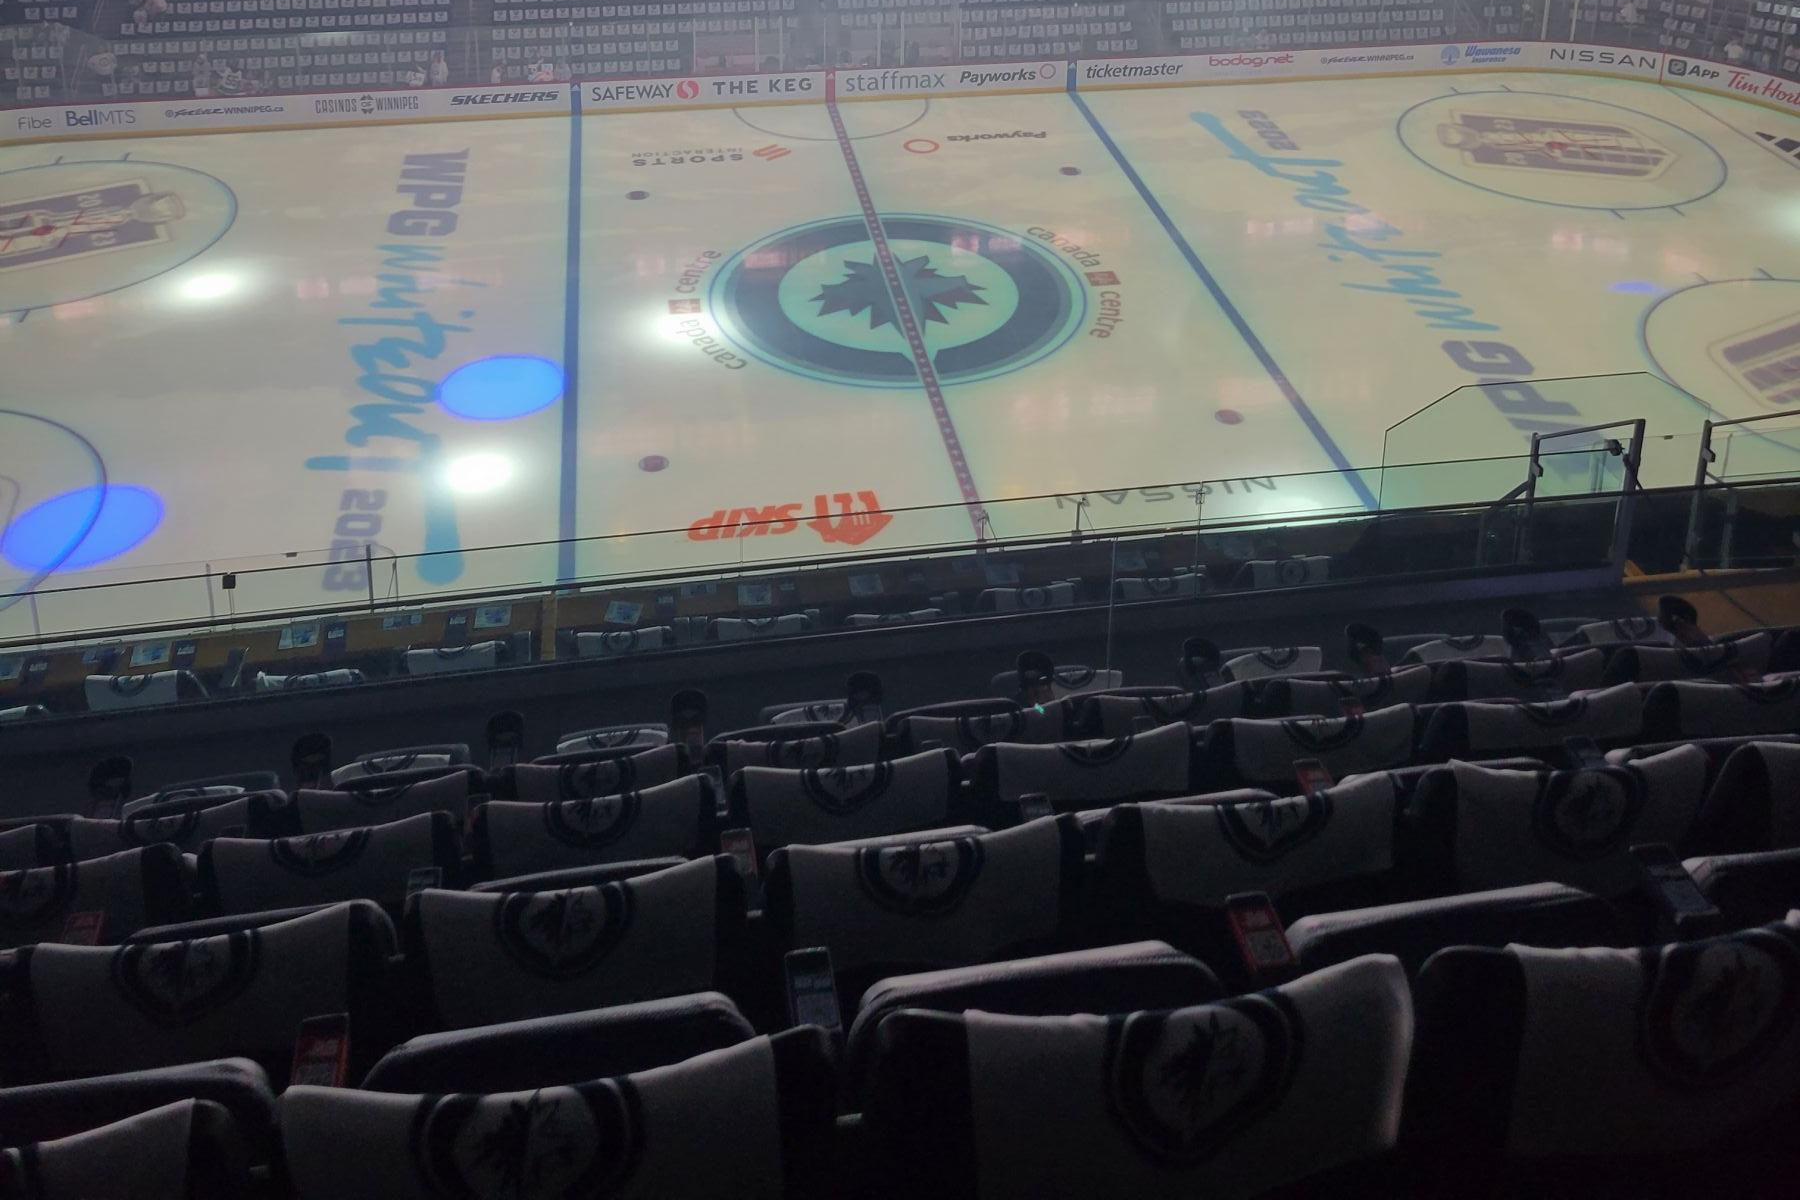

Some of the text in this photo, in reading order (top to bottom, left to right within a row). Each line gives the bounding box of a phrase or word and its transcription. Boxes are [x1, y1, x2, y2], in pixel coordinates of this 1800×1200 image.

[1208, 52, 1294, 68] bodog.net
[1464, 45, 1522, 57] Wawanesa
[1549, 48, 1657, 70] NISSAN
[959, 68, 1037, 87] Payworks
[1085, 62, 1183, 80] ticketmaster
[712, 77, 813, 97] THE KEG
[845, 70, 946, 93] staffmax
[1727, 69, 1760, 95] Tim
[450, 90, 560, 106] SKECHERS
[591, 83, 674, 102] SAFEWAY
[315, 98, 358, 115] CASINOS
[375, 95, 419, 111] WINNIPEG
[17, 116, 52, 130] Fibe
[947, 129, 1047, 143] Payworks
[632, 153, 743, 167] SPORTS
[386, 146, 470, 238] WPG
[1026, 225, 1101, 268] canada
[1088, 290, 1124, 339] centre
[686, 503, 803, 542] SKIP
